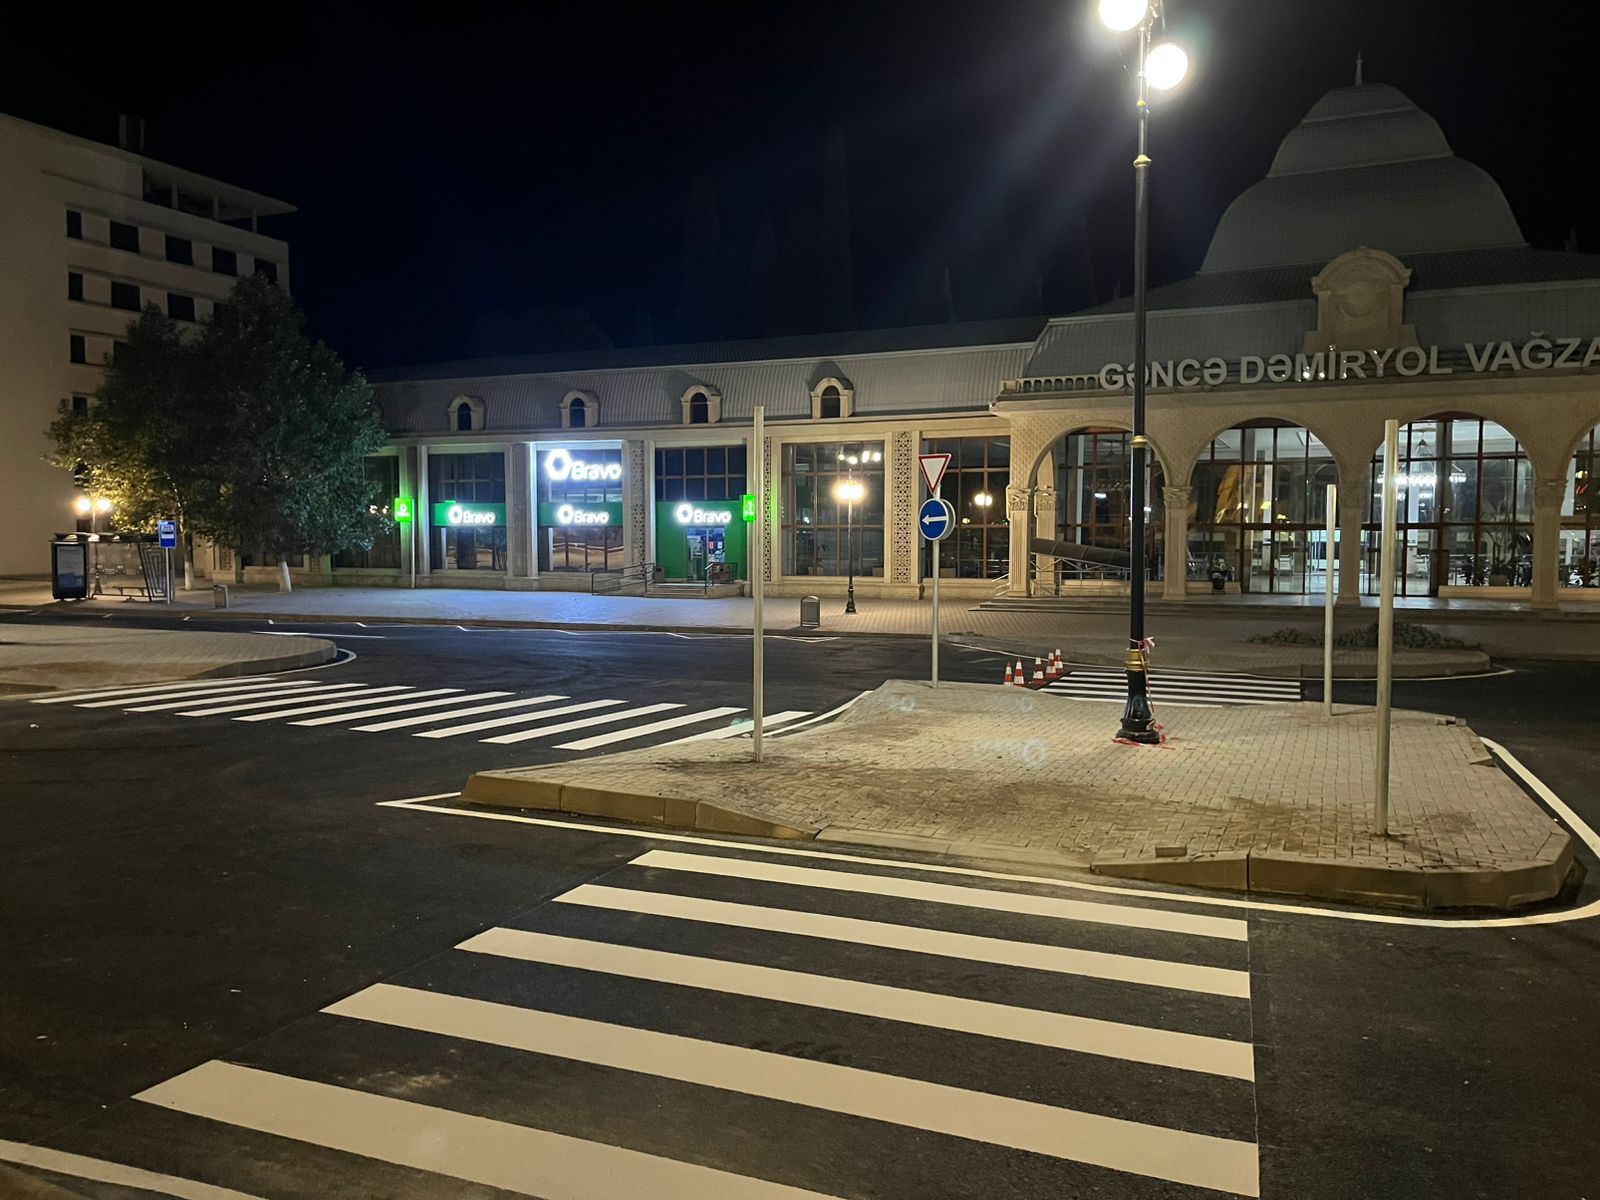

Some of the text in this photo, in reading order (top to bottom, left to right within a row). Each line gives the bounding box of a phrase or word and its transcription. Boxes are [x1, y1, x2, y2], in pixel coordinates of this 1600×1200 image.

[1240, 344, 1453, 384] DƏMİRYOL
[571, 460, 622, 480] Bravo
[463, 510, 496, 524] Bravo
[574, 509, 609, 524] Bravo
[693, 508, 732, 524] Bravo
